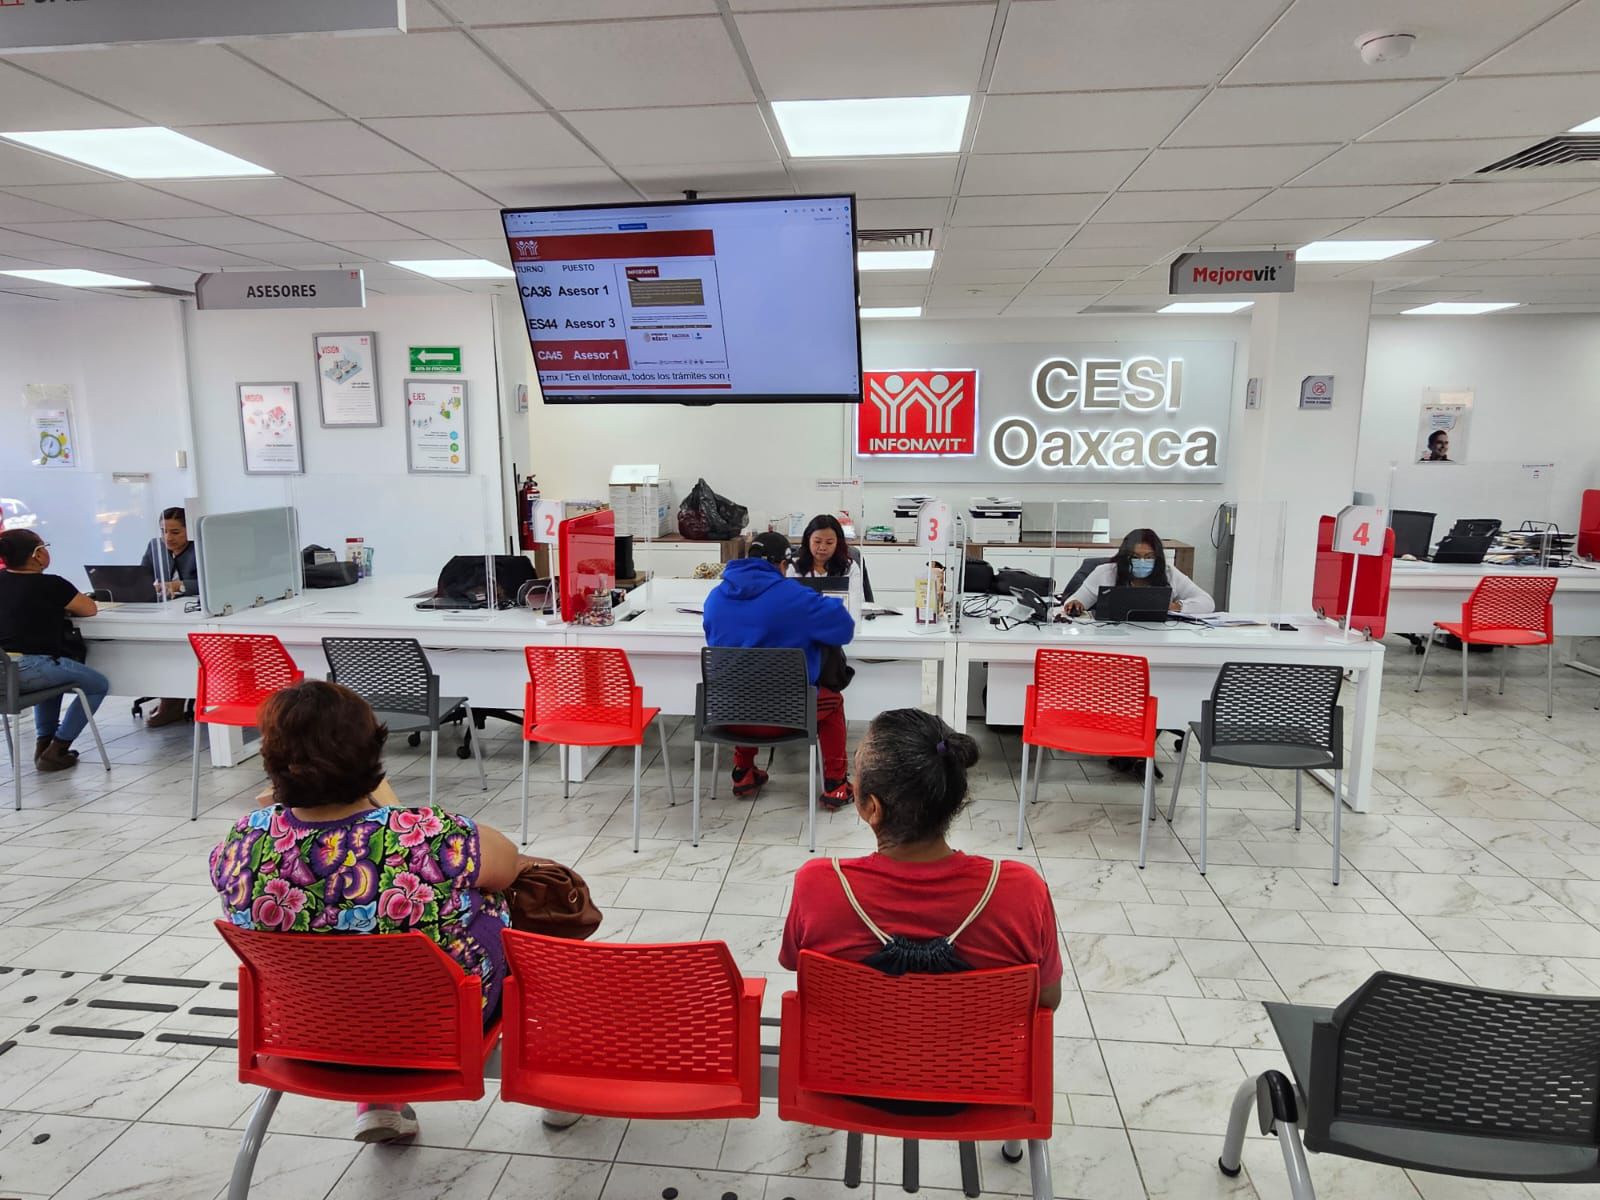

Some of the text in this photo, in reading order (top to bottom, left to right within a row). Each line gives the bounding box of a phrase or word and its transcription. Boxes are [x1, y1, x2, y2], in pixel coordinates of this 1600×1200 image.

[516, 265, 544, 273] TURNO
[562, 263, 595, 272] PUESTO
[1193, 265, 1277, 285] Mejoravit
[246, 284, 317, 299] ASESORES
[521, 285, 609, 298] CA36 Asesor 1
[529, 318, 616, 330] ES44 Asesor 3
[537, 350, 619, 361] CA45 Asesor 1
[632, 372, 655, 381] todos
[657, 372, 670, 380] los
[672, 371, 707, 380] trámites
[1036, 358, 1184, 409] CESI
[412, 392, 426, 401] EJES
[869, 438, 963, 451] INFONAVIT
[993, 418, 1218, 467] Oaxaca
[544, 514, 556, 537] 2
[928, 517, 938, 541] 3
[1352, 522, 1370, 546] 4
